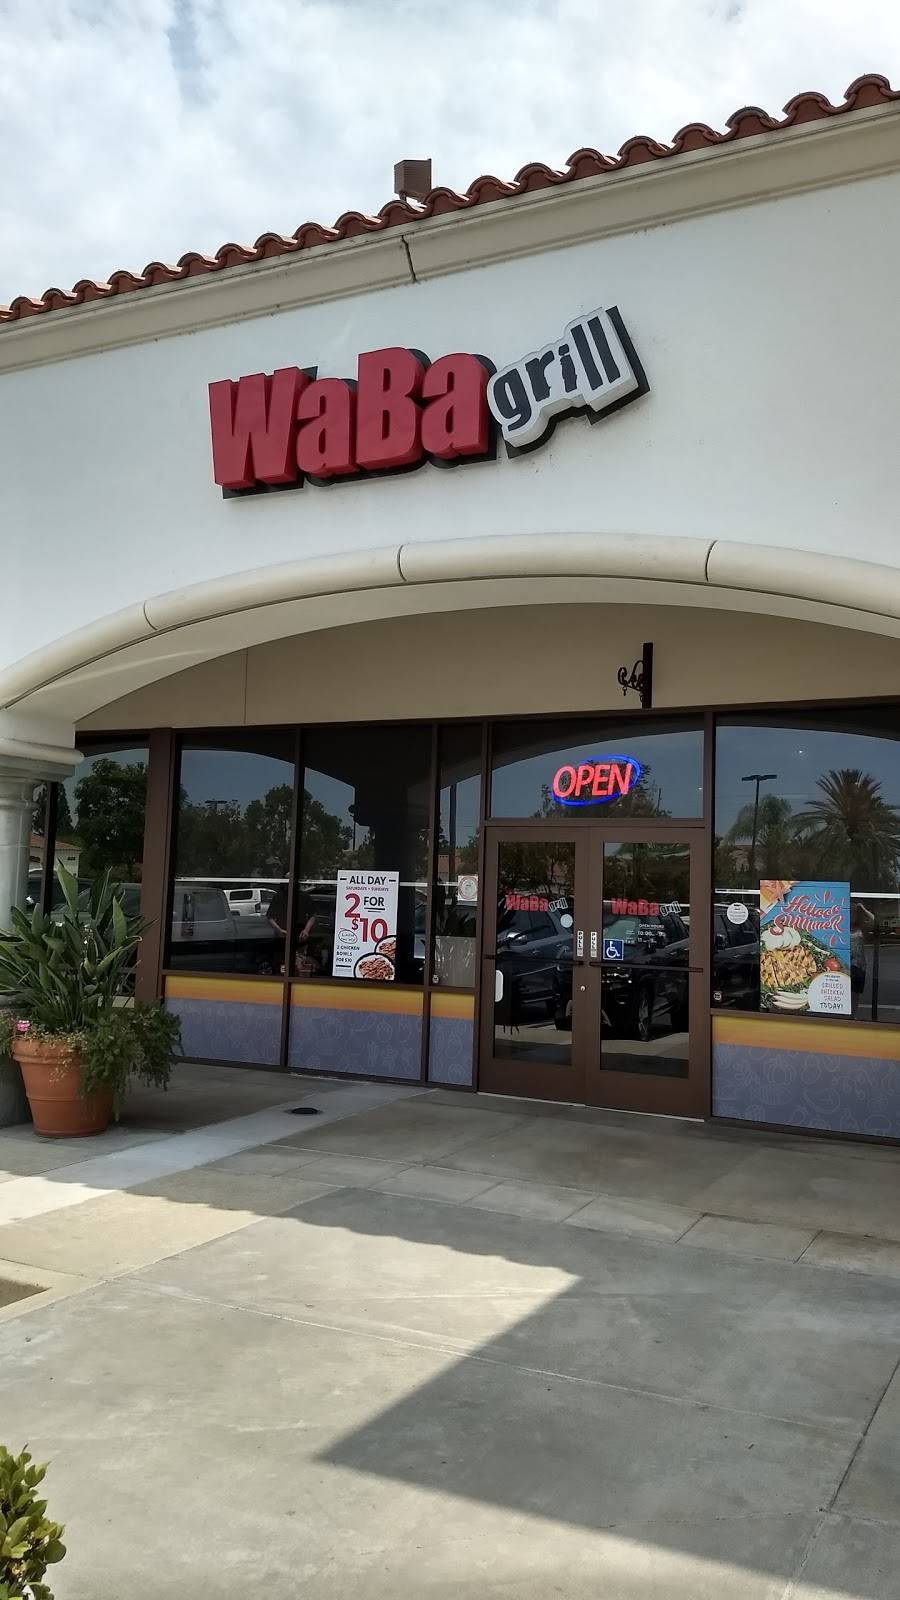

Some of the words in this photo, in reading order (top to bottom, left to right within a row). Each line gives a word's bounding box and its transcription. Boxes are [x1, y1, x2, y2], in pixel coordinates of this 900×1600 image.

[208, 346, 489, 488] WaBa
[493, 316, 622, 433] grill
[553, 763, 632, 798] OPEN
[349, 875, 365, 884] ALL
[367, 876, 387, 885] DAY
[344, 893, 360, 918] 2
[363, 896, 385, 906] FOR
[505, 894, 549, 912] WaBa
[549, 897, 568, 912] grill
[610, 898, 660, 917] WaBa
[660, 901, 681, 916] grill
[351, 917, 388, 943] $10
